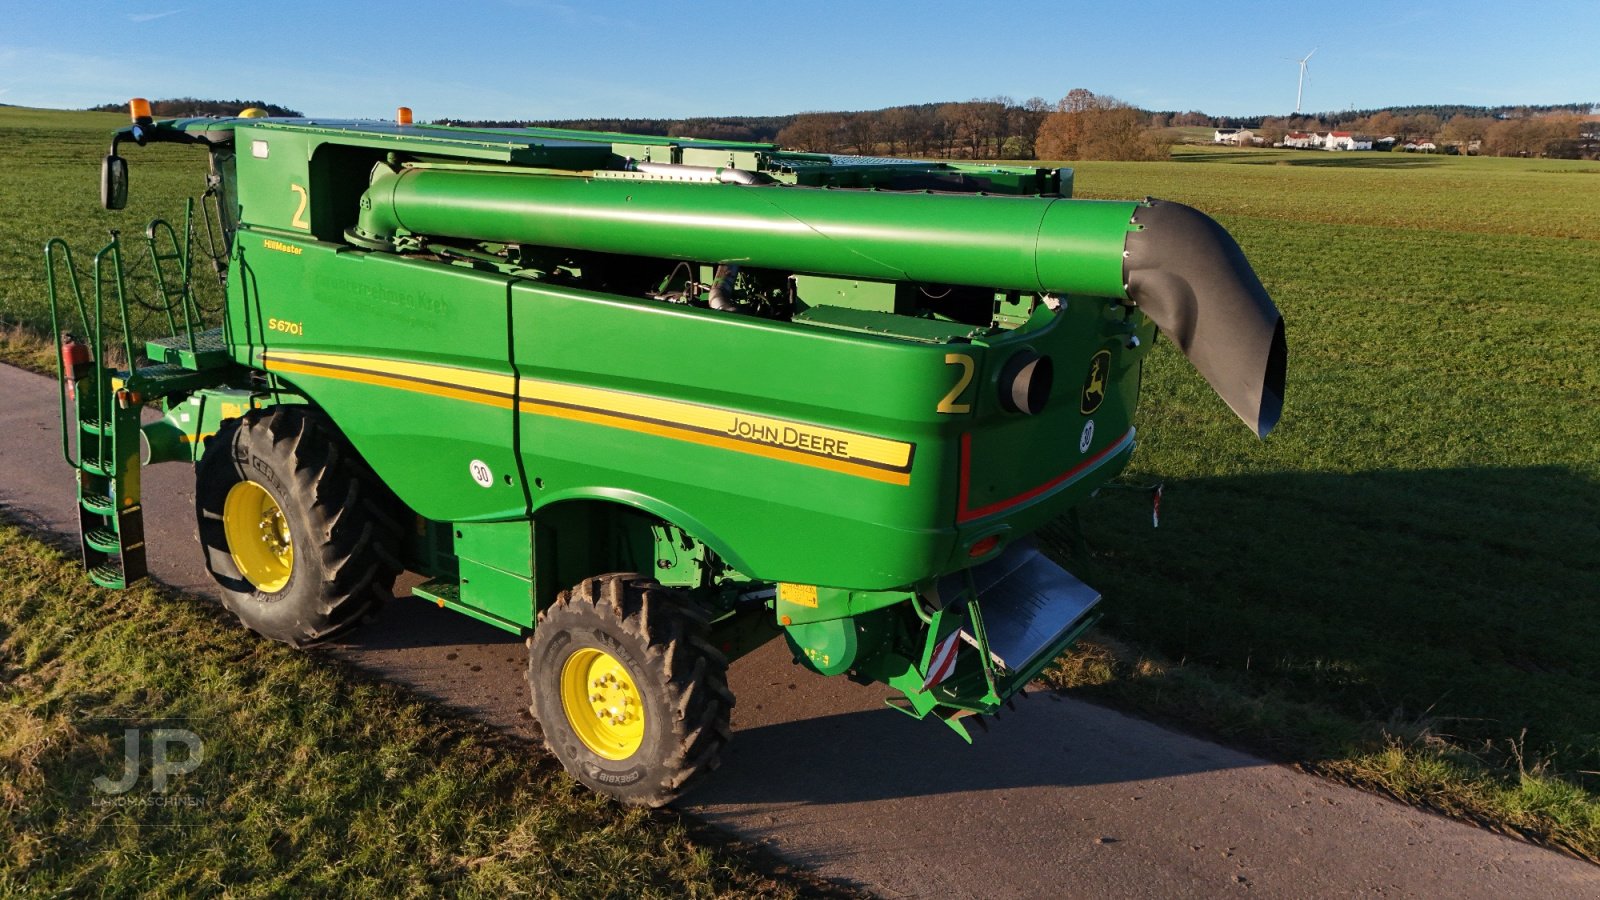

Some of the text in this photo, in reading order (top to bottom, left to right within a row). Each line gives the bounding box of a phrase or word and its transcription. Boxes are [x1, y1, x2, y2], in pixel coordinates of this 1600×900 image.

[291, 184, 309, 230] 2
[264, 239, 303, 256] HillMaster
[936, 353, 975, 414] 2
[728, 417, 849, 456] JOHN DEERE
[1081, 425, 1092, 448] 30
[473, 465, 489, 483] 30
